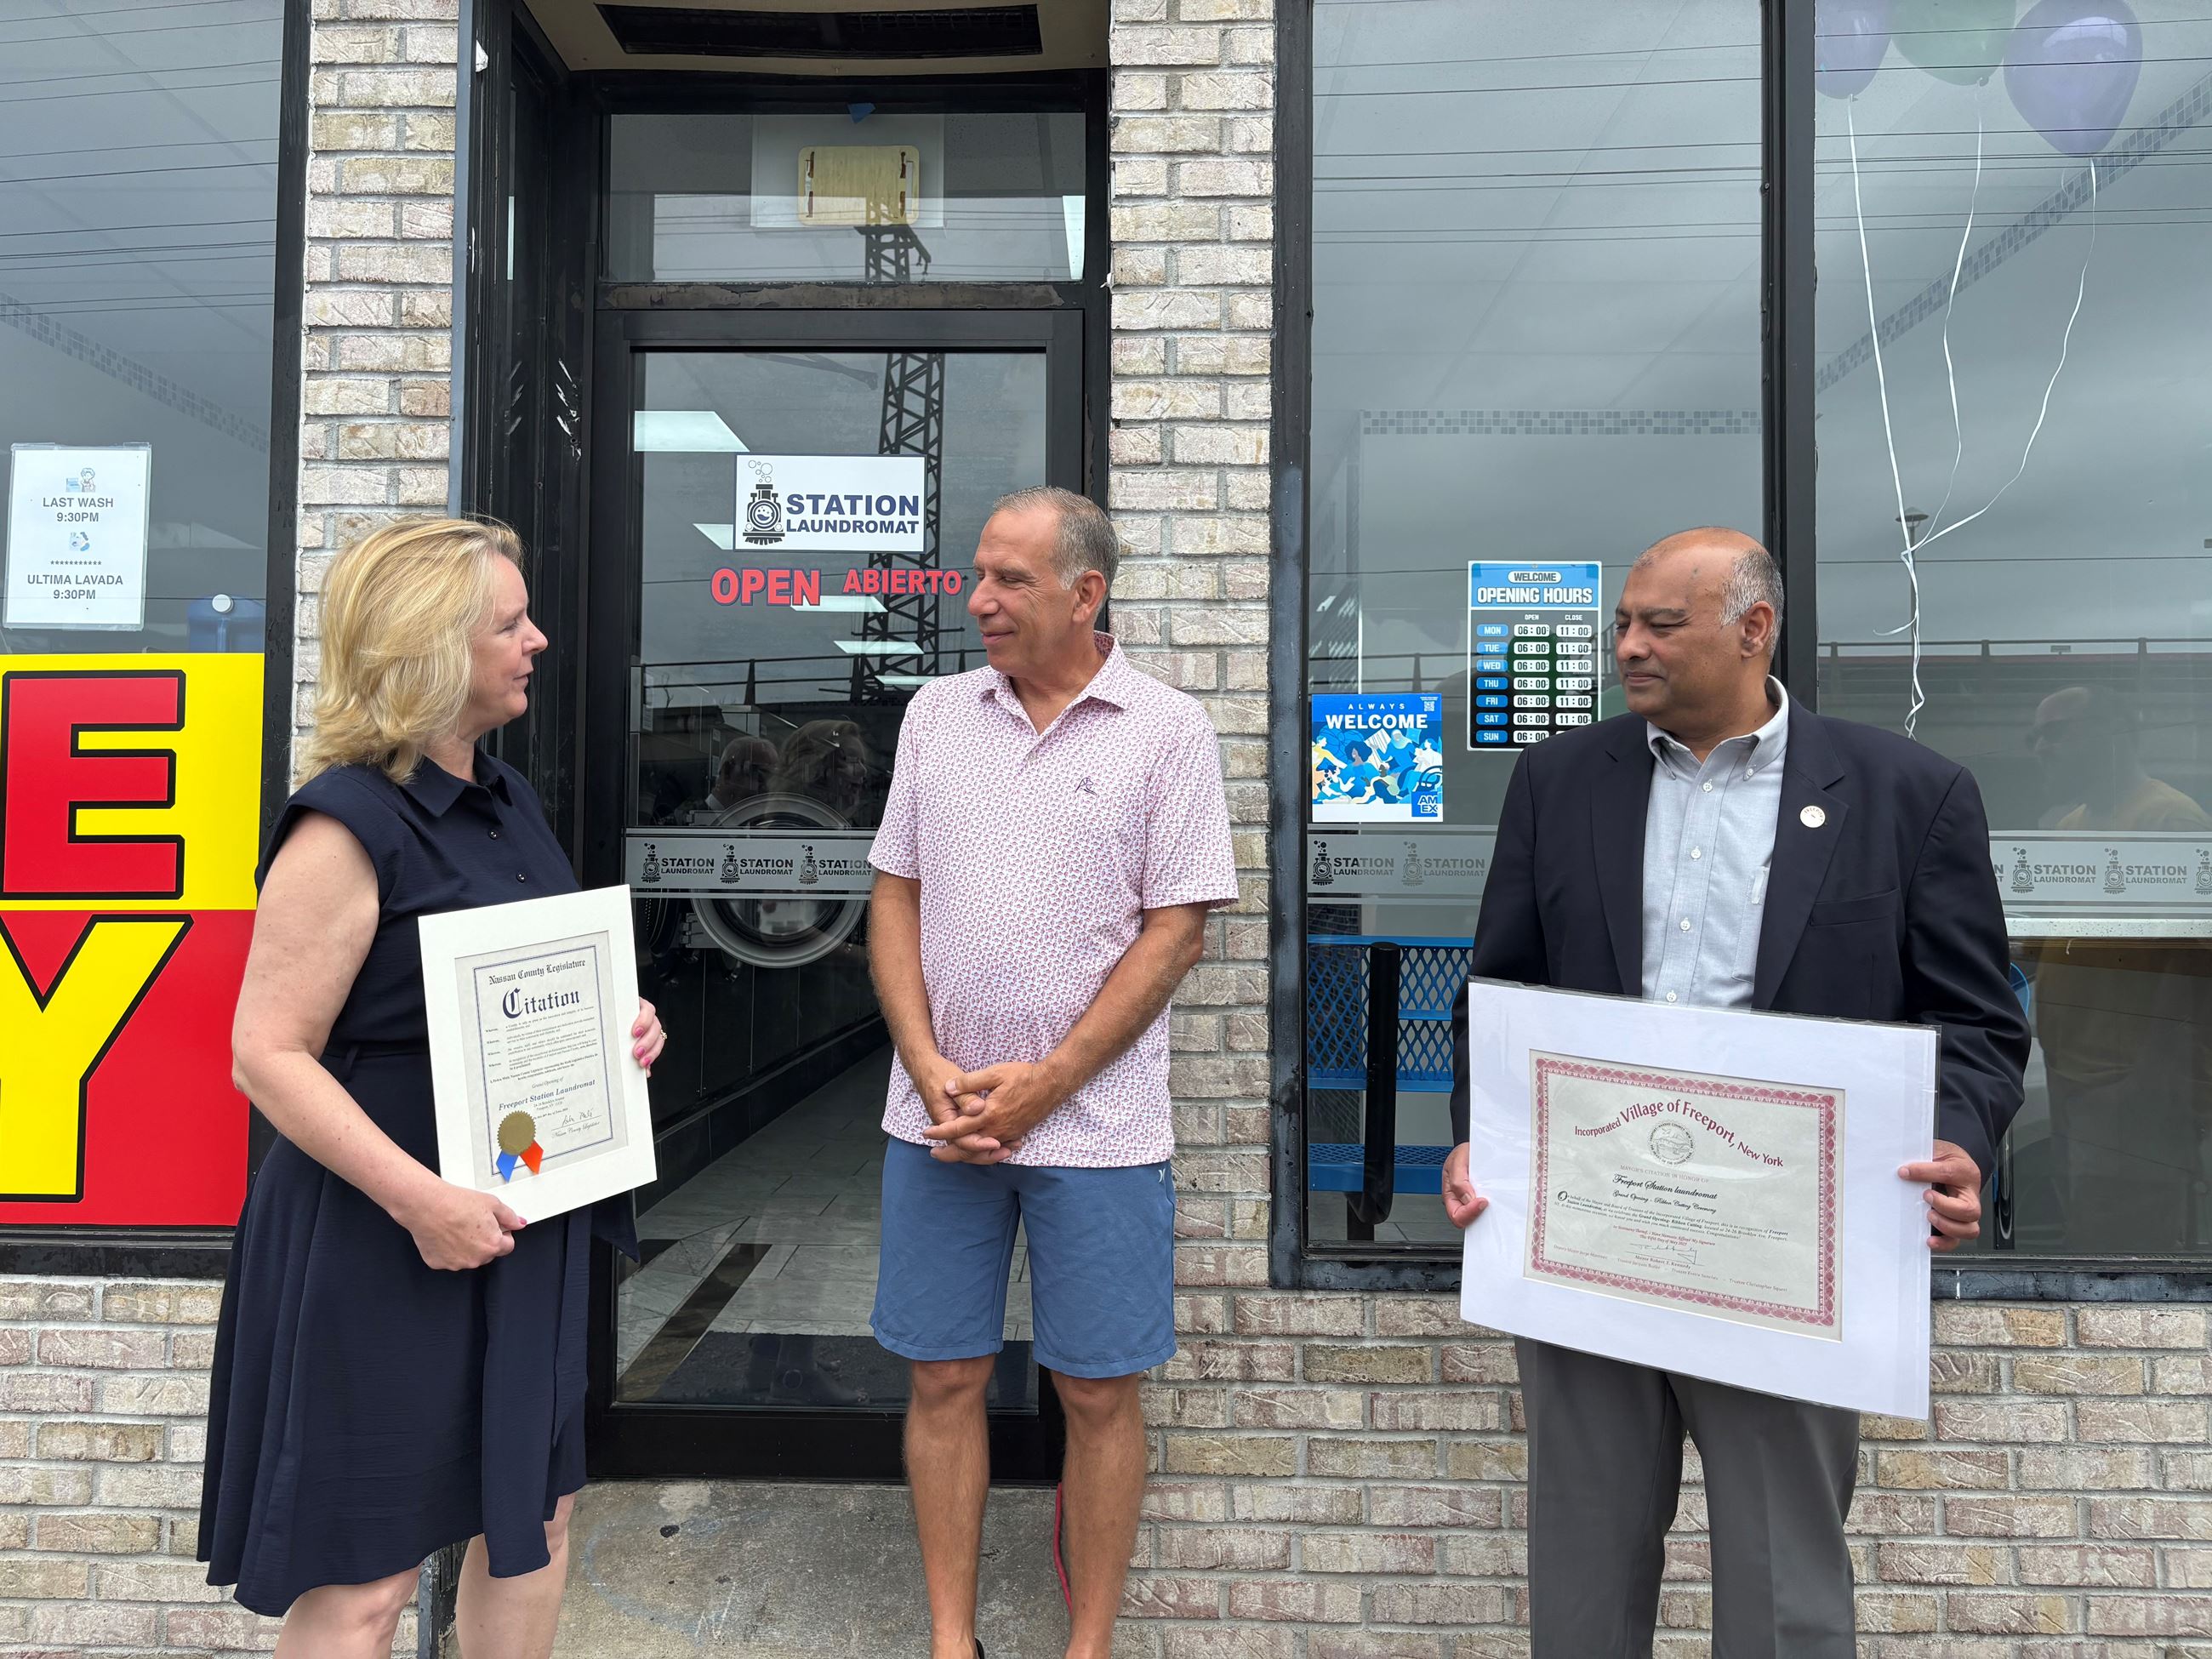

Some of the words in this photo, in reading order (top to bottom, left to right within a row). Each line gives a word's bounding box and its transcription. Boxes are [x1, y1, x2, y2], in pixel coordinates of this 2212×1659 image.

[43, 497, 75, 508] LAST
[77, 497, 114, 508] WASH
[786, 493, 919, 516] STATION
[56, 512, 100, 522] 9:30PM
[786, 519, 920, 534] LAUNDROMAT
[27, 574, 71, 585] ULTIMA
[75, 574, 123, 585] LAVADA
[842, 568, 963, 596] ABIERTO
[1514, 573, 1557, 582] WELCOME
[710, 567, 822, 607] OPEN
[53, 589, 96, 600] 9:30PM
[1477, 587, 1540, 604] OPENING
[1543, 588, 1593, 605] HOURS
[1484, 626, 1502, 635] MON
[1484, 644, 1499, 653] TUE
[1483, 662, 1501, 670] WED
[1484, 680, 1499, 688] THU
[1485, 697, 1498, 705] FRI
[1325, 714, 1428, 729] WELCOME
[1484, 715, 1499, 723] SAT
[1484, 733, 1499, 741] SUN
[661, 858, 715, 867] STATION
[740, 858, 794, 869] STATION
[818, 859, 872, 869] STATION
[1333, 857, 1394, 868] STATION
[1423, 858, 1485, 869] STATION
[2033, 864, 2096, 875] STATION
[2125, 865, 2187, 875] STATION
[489, 973, 516, 985] Nassau
[518, 967, 544, 979] County
[546, 960, 585, 973] Legislature
[502, 988, 579, 1019] Citation
[499, 1097, 527, 1111] Freeport
[529, 1092, 554, 1103] Station
[556, 1079, 596, 1096] Laundromat
[1575, 1117, 1622, 1137] Incorporated
[1620, 1102, 1664, 1123] Village
[1667, 1099, 1681, 1113] of
[1682, 1102, 1736, 1148] Freeport,
[1736, 1141, 1760, 1160] New
[1762, 1153, 1784, 1167] York
[1645, 1169, 1670, 1177] CITATION
[1612, 1174, 1644, 1189] Freeport
[1645, 1181, 1673, 1192] Station
[1674, 1186, 1717, 1200] laundromat
[1630, 1193, 1649, 1203] Opening
[1654, 1197, 1672, 1206] Ribbon
